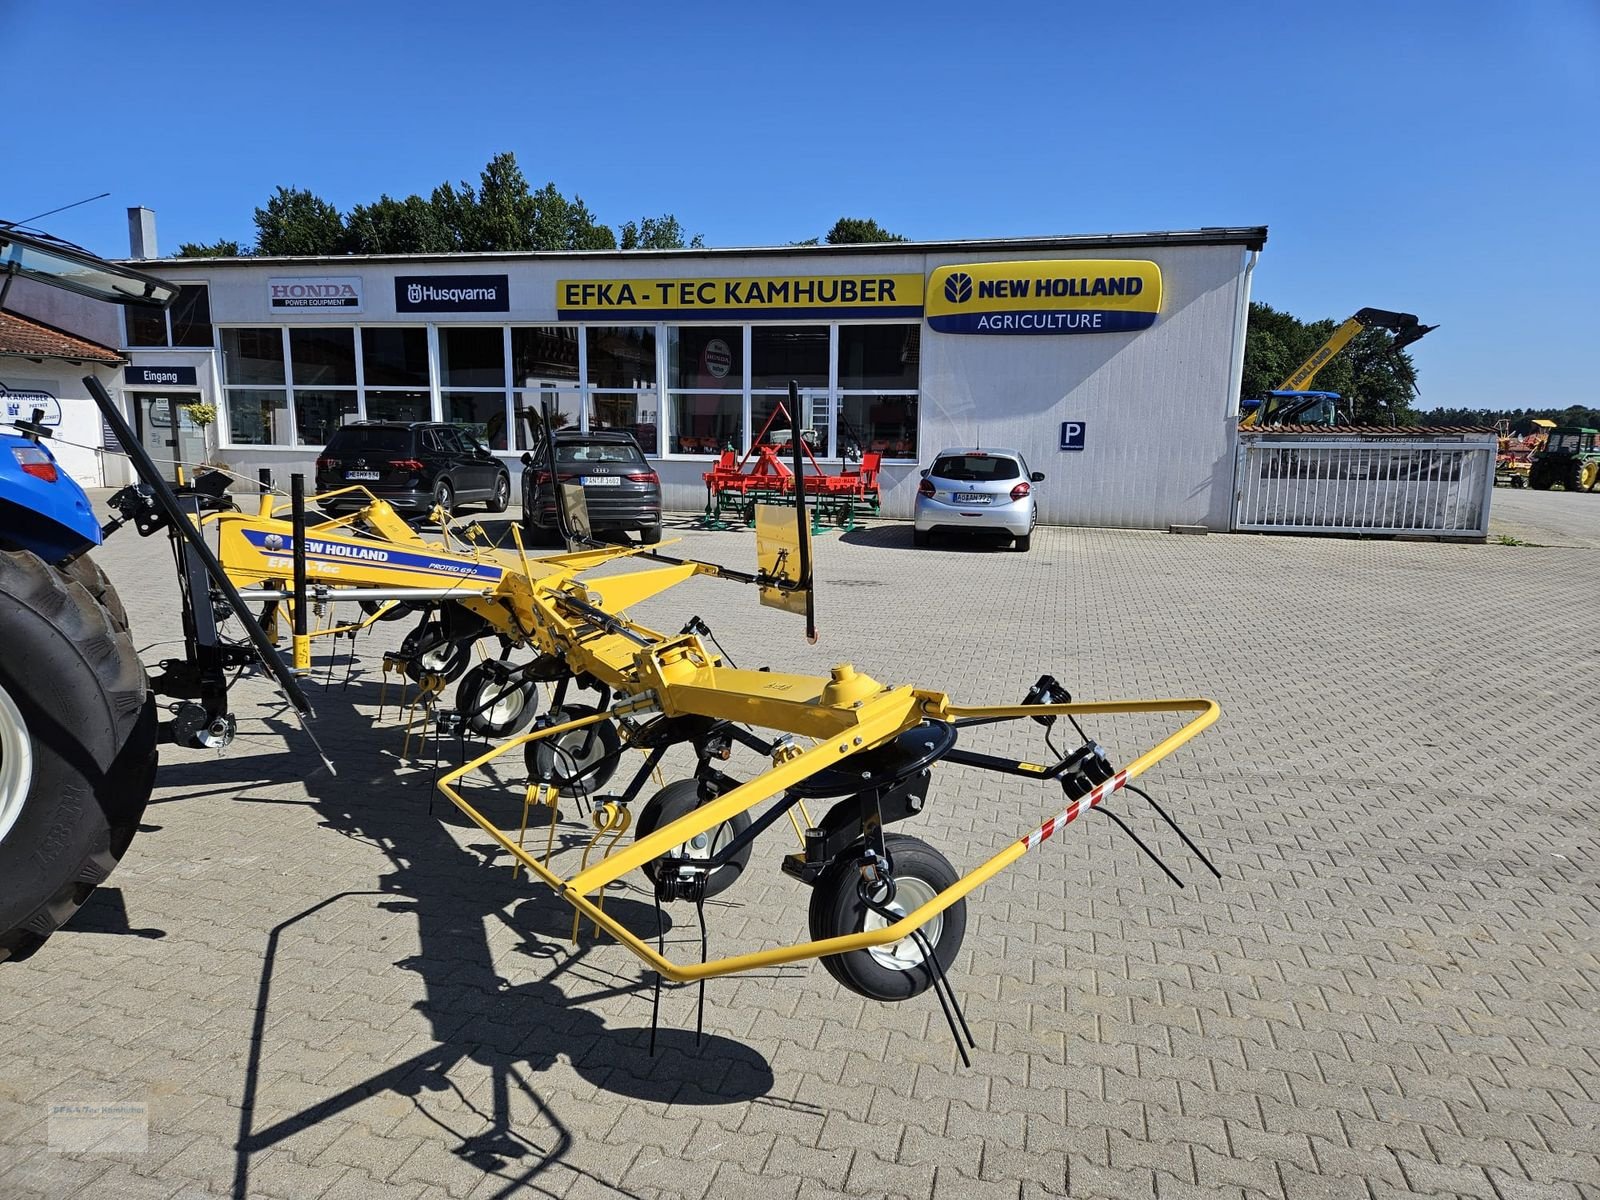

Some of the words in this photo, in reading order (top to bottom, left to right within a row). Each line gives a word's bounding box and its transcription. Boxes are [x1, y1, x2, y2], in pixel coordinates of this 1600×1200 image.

[271, 284, 357, 298] HONDA
[423, 286, 497, 303] Husqvarna
[565, 283, 637, 306] EFKA
[656, 283, 717, 305] TEC
[725, 279, 897, 305] KAMHUBER
[978, 279, 1030, 299] NEW
[1035, 276, 1144, 297] HOLLAND
[309, 298, 345, 306] EQUIPMENT
[977, 313, 1103, 330] AGRICULTURE
[143, 370, 178, 383] Eingang
[6, 393, 49, 401] KAMHUBER
[1065, 423, 1081, 444] P
[291, 538, 324, 553] EW
[325, 543, 389, 562] HOLLAND
